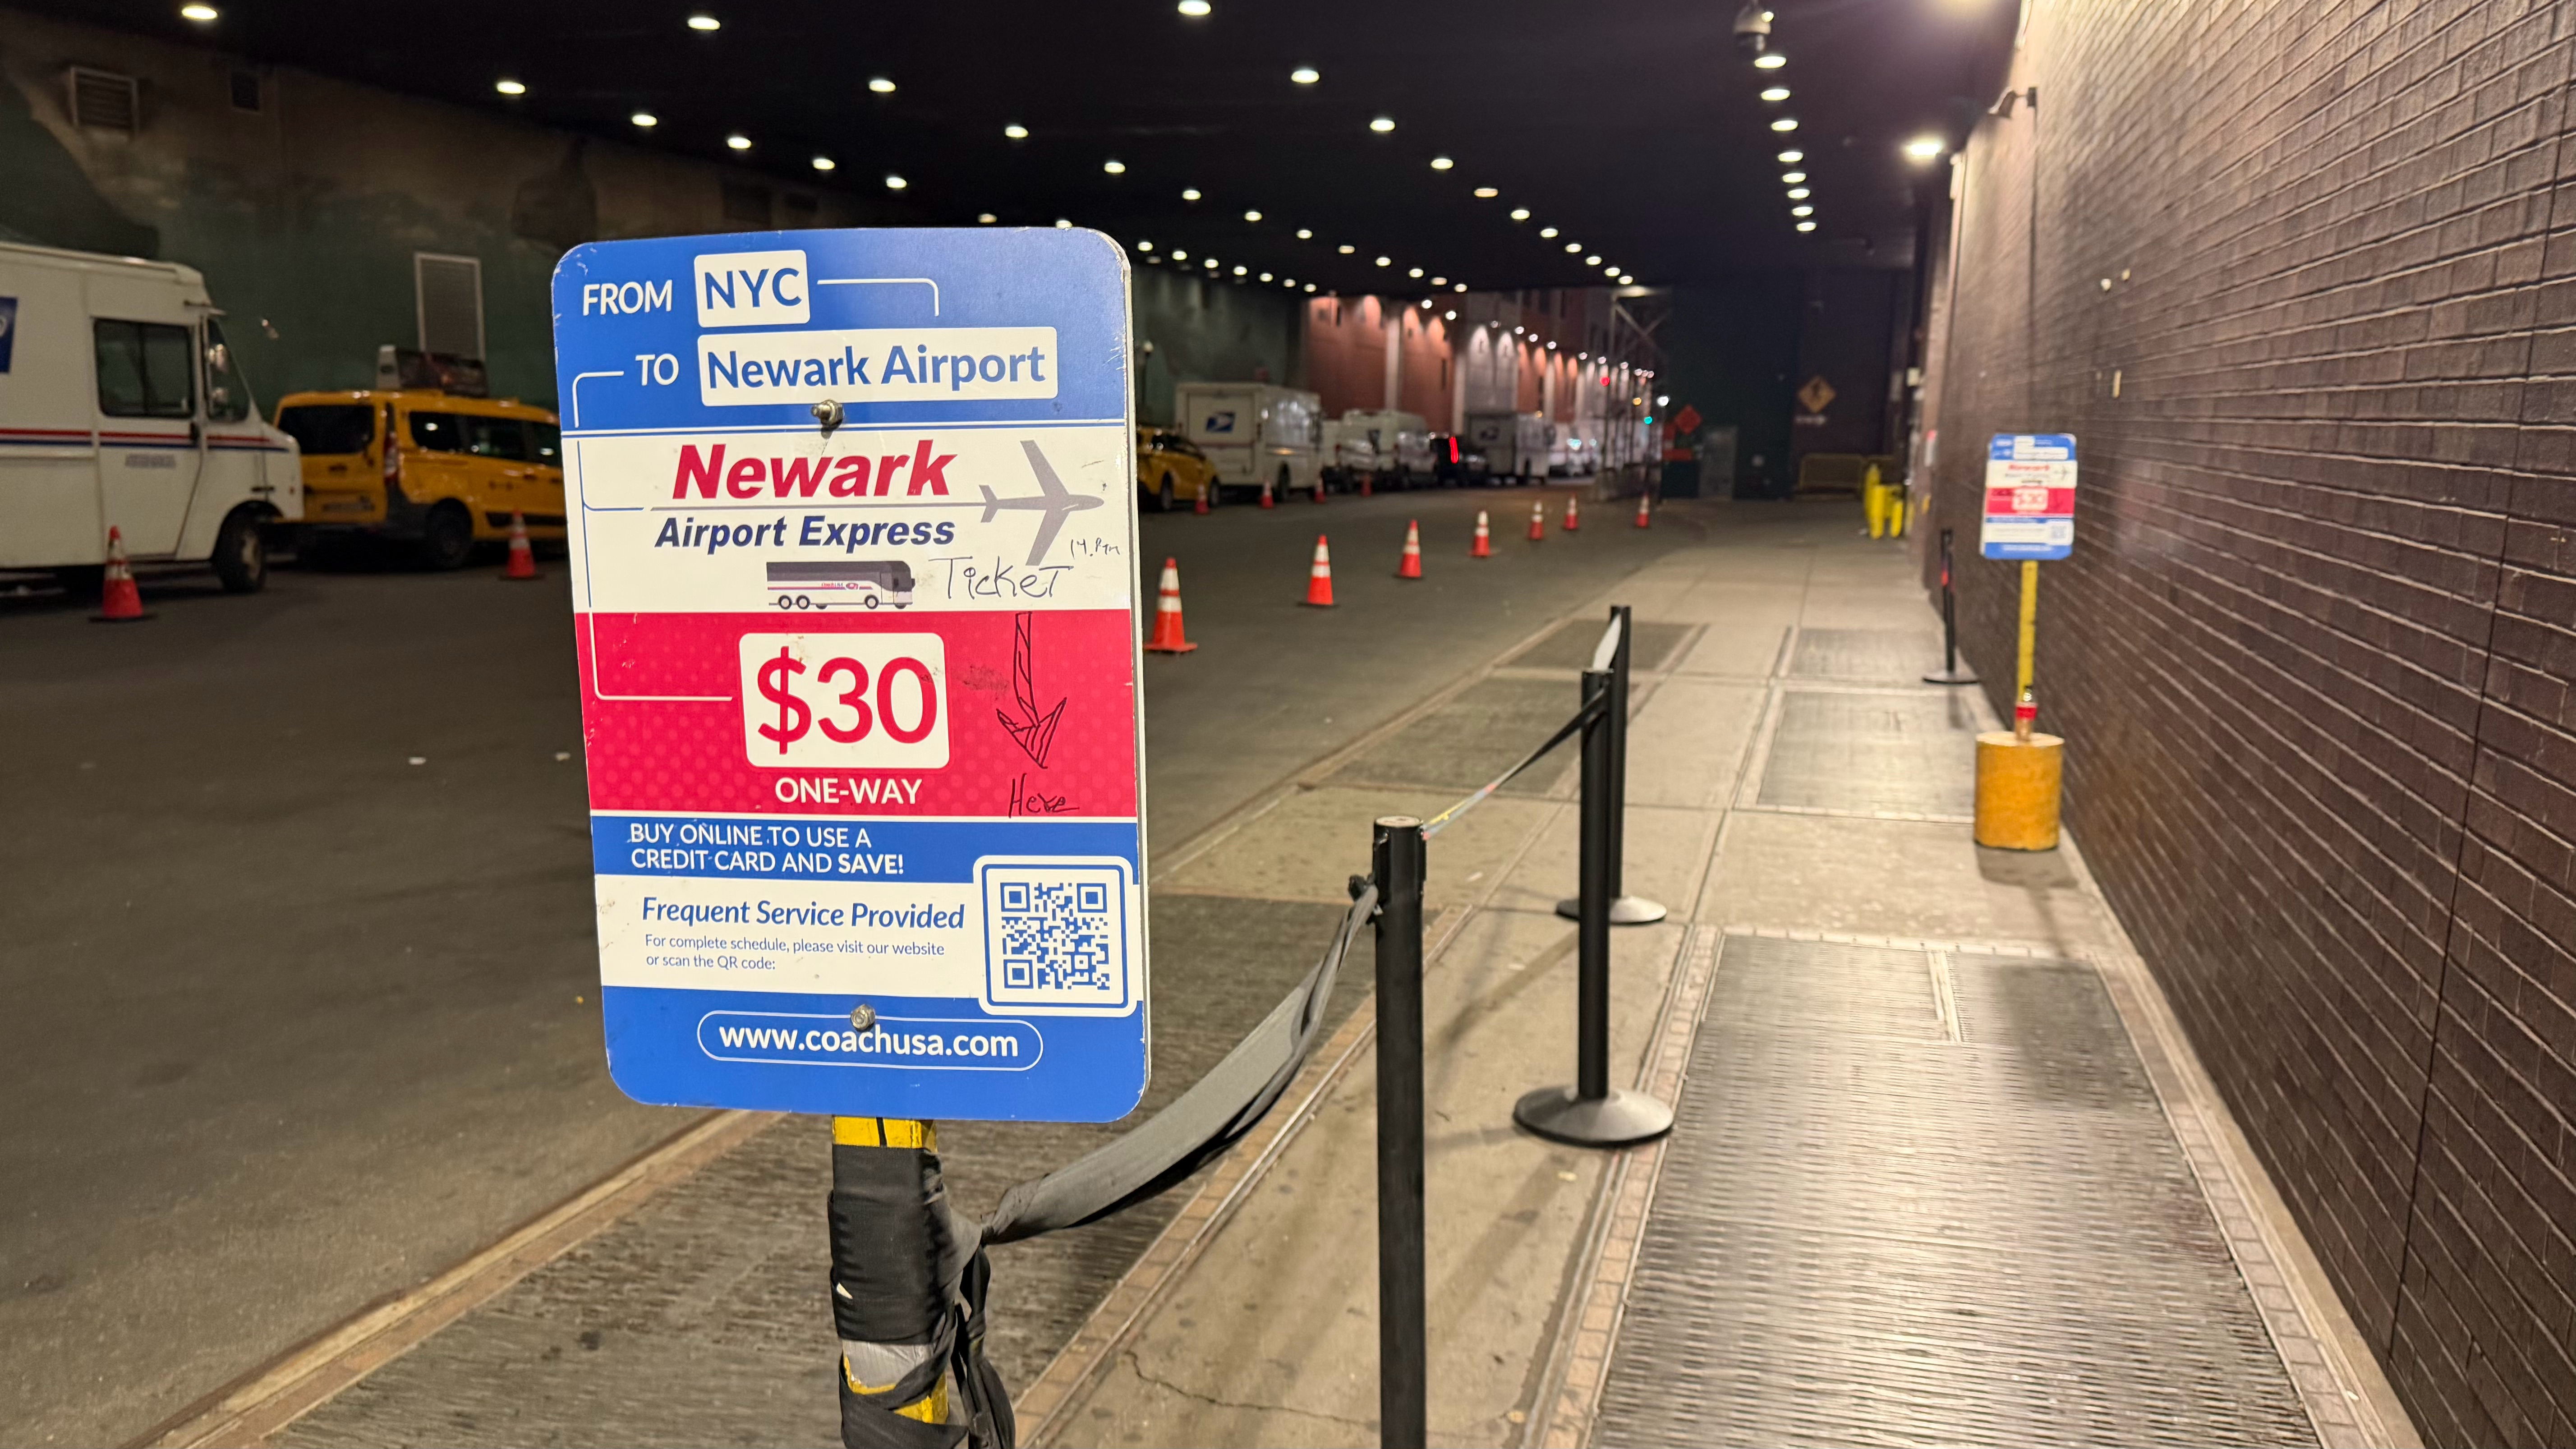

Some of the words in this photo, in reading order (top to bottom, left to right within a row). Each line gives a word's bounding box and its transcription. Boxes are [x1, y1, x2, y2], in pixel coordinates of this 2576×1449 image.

[583, 280, 672, 316] FROM
[705, 268, 801, 309] NYC
[635, 354, 679, 386] TO
[708, 346, 871, 388] Newark
[881, 345, 1045, 391] Airport
[672, 439, 957, 499] Newark
[654, 516, 787, 555] Airport
[799, 515, 955, 556] Express
[758, 646, 937, 754] $30
[776, 777, 922, 804] ONE-WAY
[631, 823, 674, 843] BUY
[680, 824, 763, 845] ONLINE
[768, 826, 800, 846] TO
[807, 827, 849, 847] USE
[856, 828, 871, 848] A
[631, 848, 708, 869] CREDIT
[715, 851, 775, 871] CARD
[782, 852, 832, 872] AND
[838, 854, 903, 874] SAVE!
[643, 897, 750, 926] Frequent
[756, 901, 844, 926] Service
[852, 903, 965, 928] Provided
[646, 934, 666, 946] For
[670, 935, 727, 950] complete
[731, 937, 789, 952] schedule,
[794, 938, 833, 954] please
[837, 940, 863, 953] visit
[867, 944, 888, 954] our
[892, 942, 944, 955] website
[647, 956, 659, 965] or
[663, 957, 690, 966] scan
[694, 954, 713, 967] the
[718, 956, 738, 970] QR
[741, 957, 775, 970] code:
[719, 1024, 1018, 1057] www.coachusa.com
